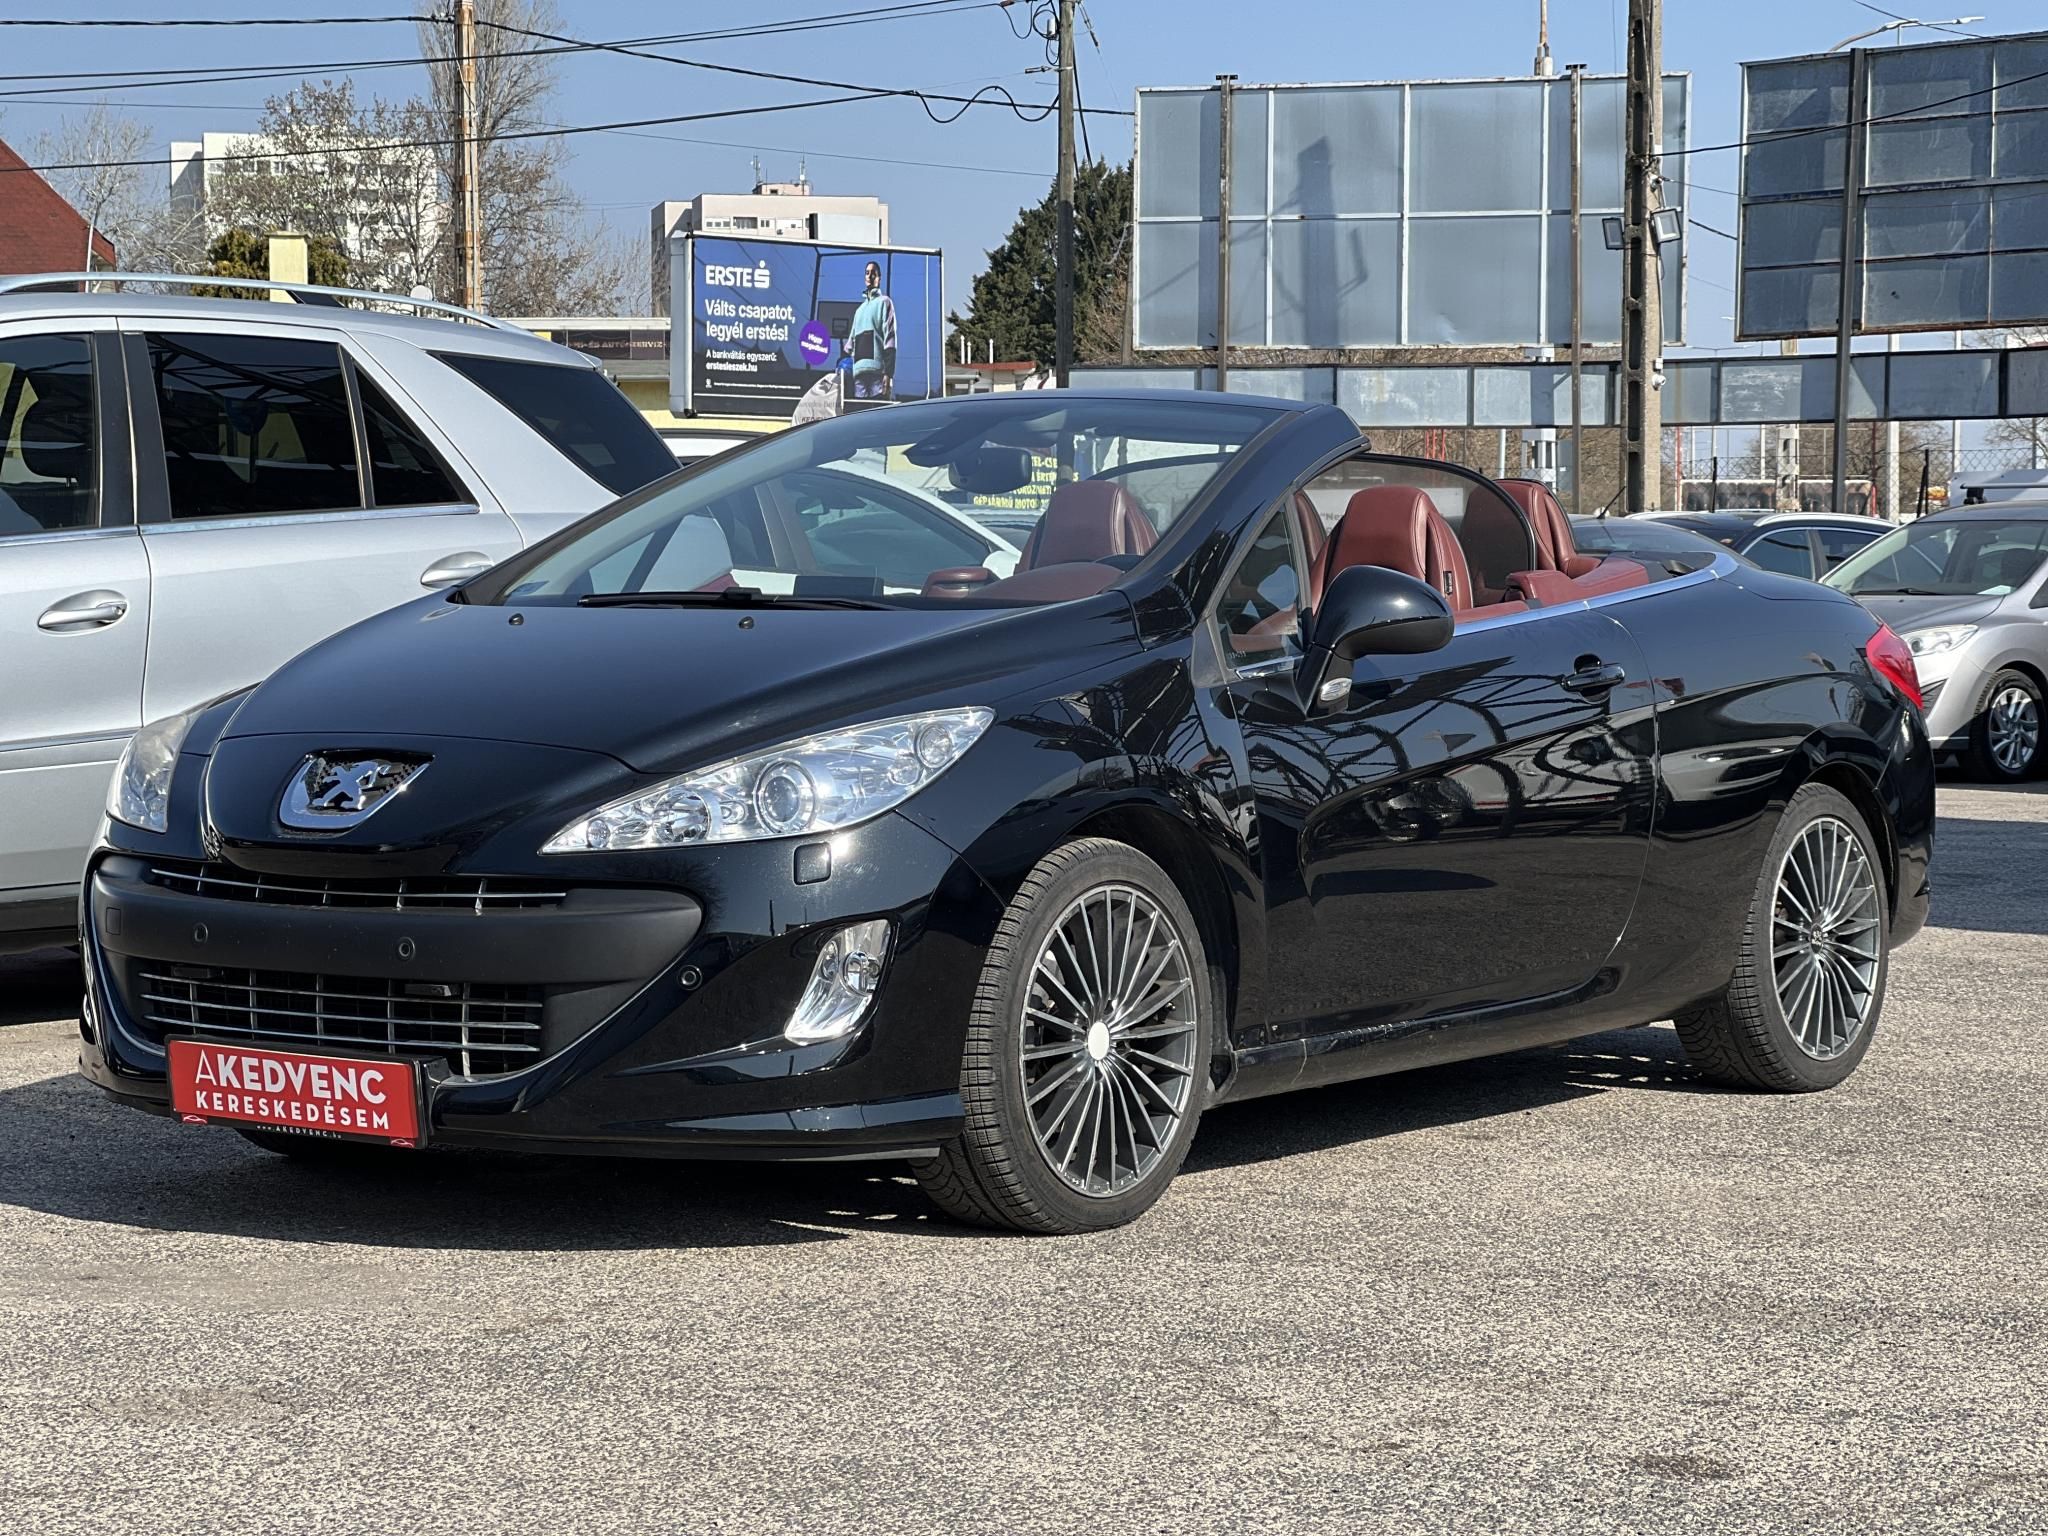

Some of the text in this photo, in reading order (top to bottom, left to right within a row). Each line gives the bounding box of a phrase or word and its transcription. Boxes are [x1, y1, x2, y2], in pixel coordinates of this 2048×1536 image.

[705, 264, 753, 288] ERSTE
[705, 298, 796, 324] Válts csapatot,
[706, 320, 789, 342] legyél erstés!
[706, 349, 711, 358] A
[712, 350, 746, 361] bankváltás
[195, 1048, 387, 1105] AKEDVENC
[195, 1090, 389, 1130] KERESKEDÉSEM
